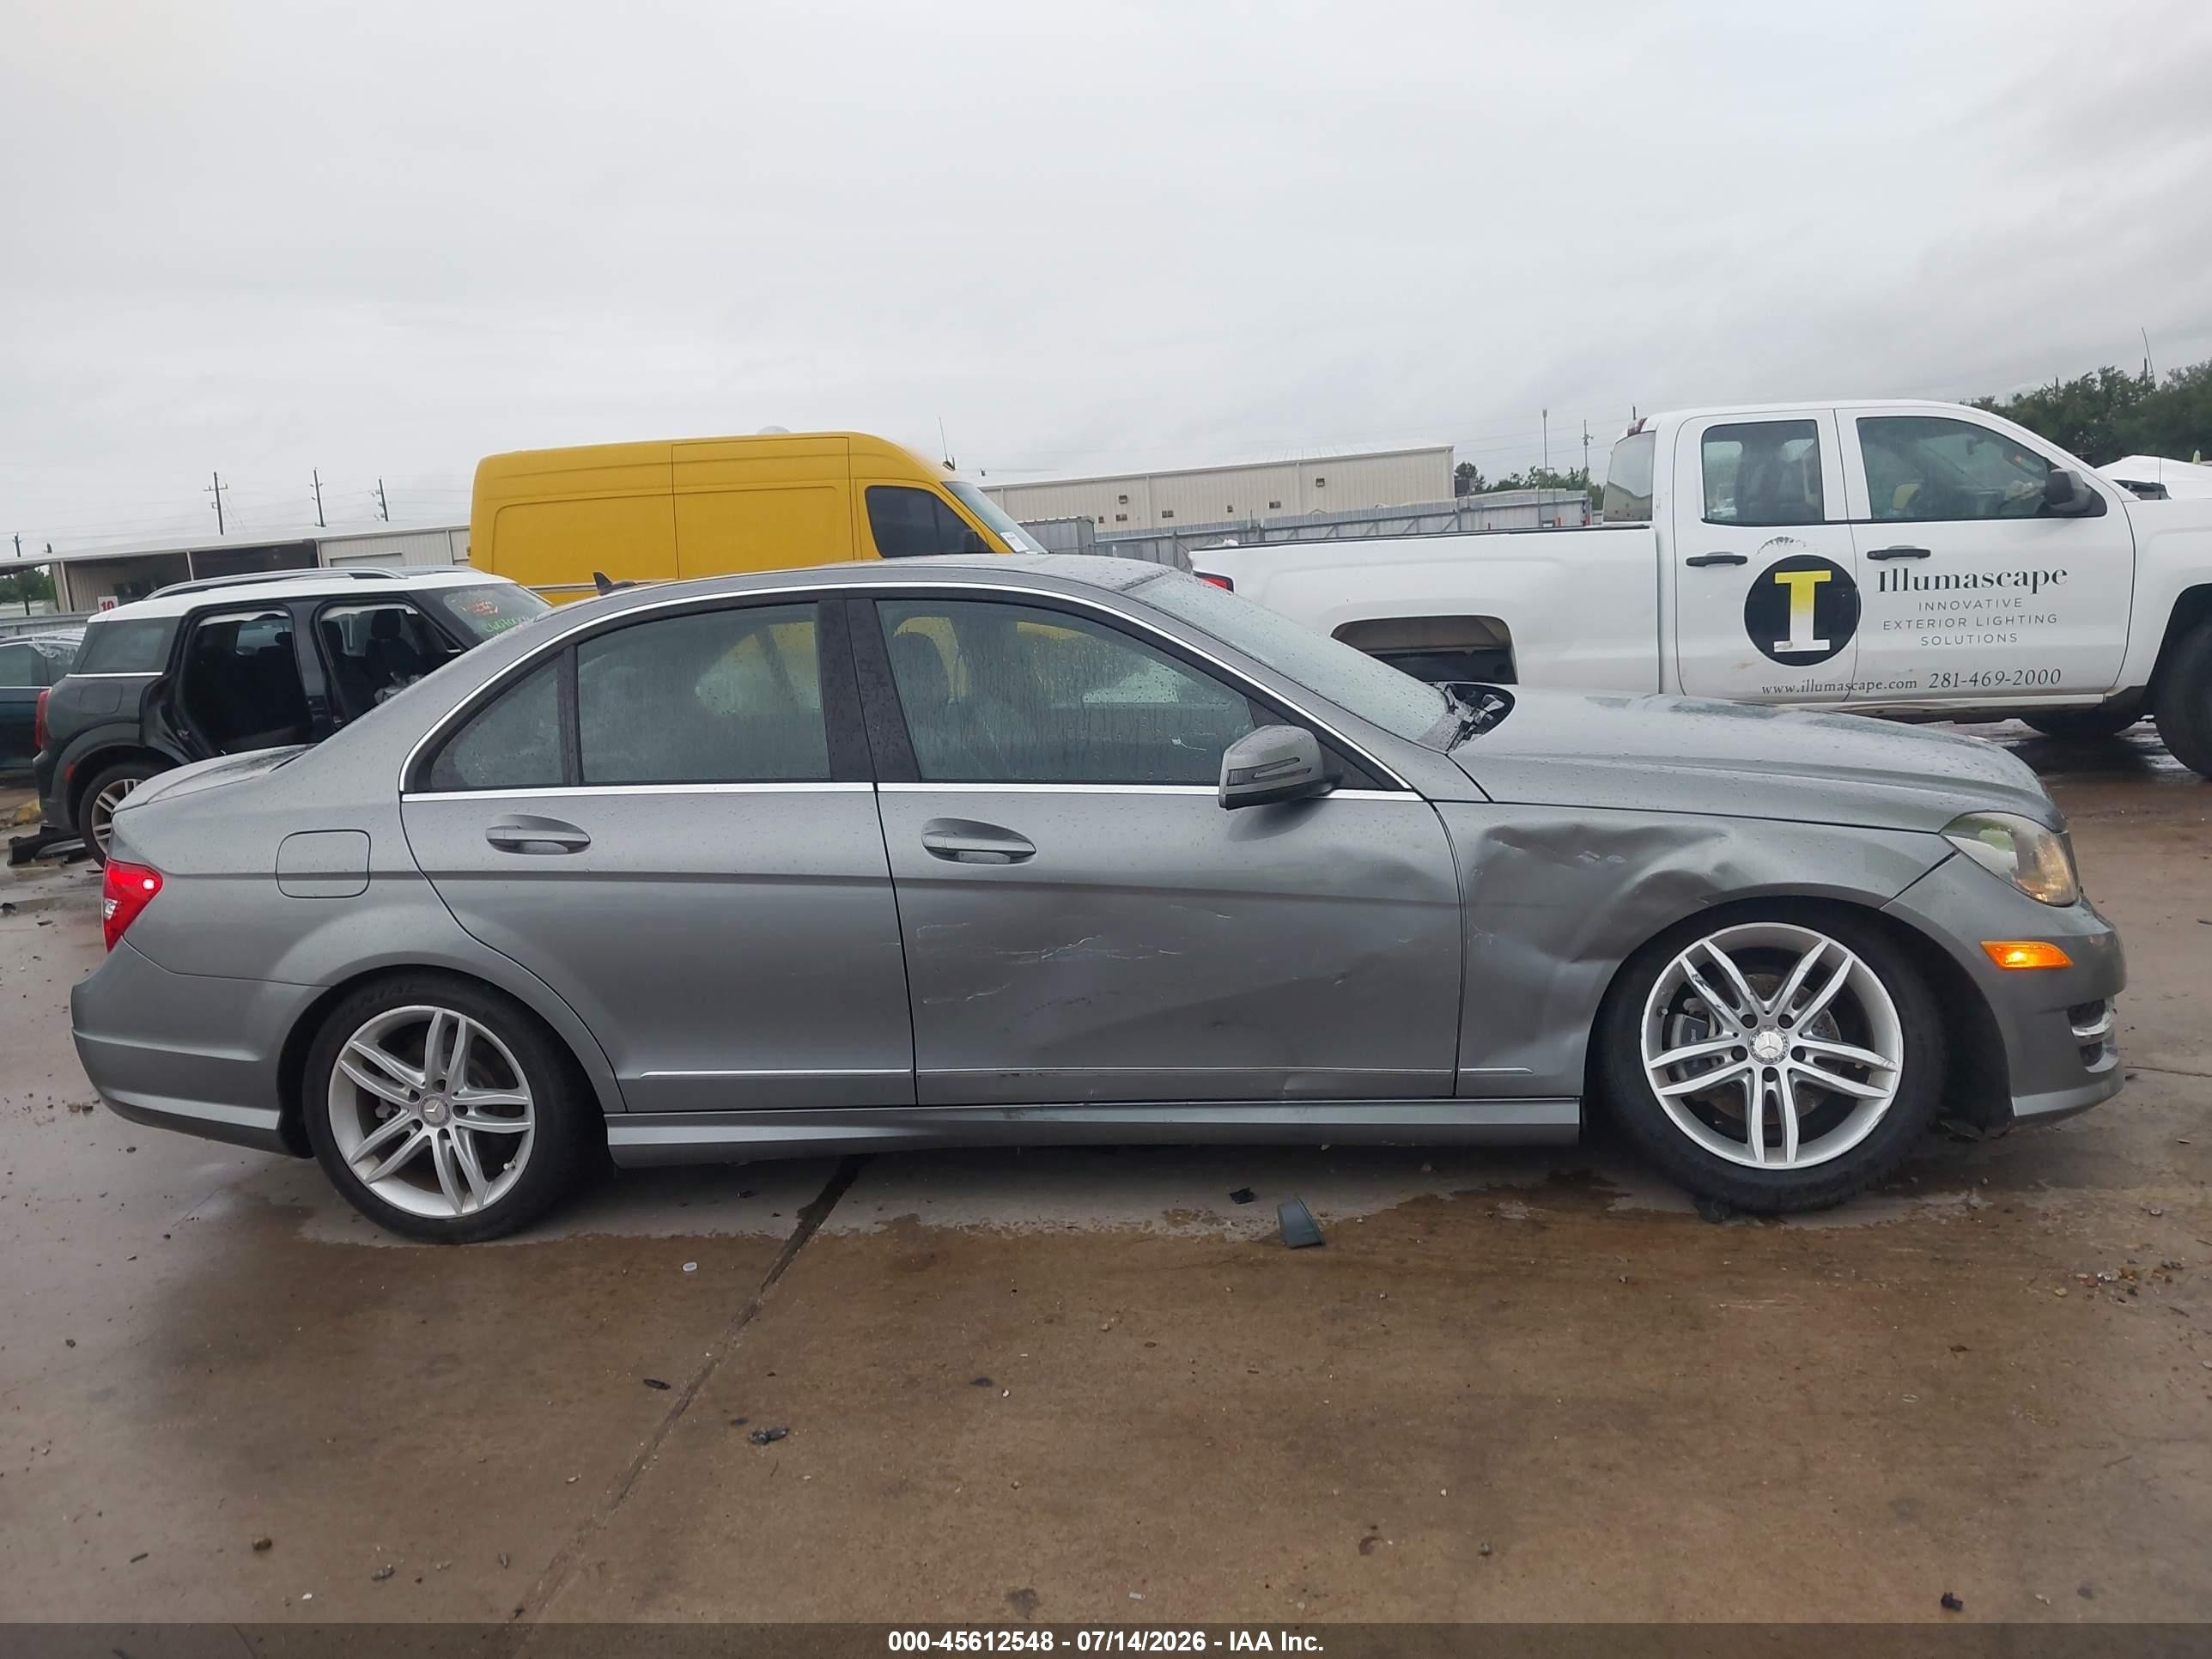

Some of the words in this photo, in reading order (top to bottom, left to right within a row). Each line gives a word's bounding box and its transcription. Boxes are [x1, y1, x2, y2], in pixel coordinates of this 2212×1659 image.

[1877, 568, 2068, 594] Illumascape
[1774, 570, 1831, 653] I
[1918, 598, 2022, 611] INNOVATIVE
[1883, 617, 1966, 630] EXTERIOR
[1976, 614, 2057, 627] LIGHTING
[1921, 633, 2018, 646] SOLUTIONS
[1761, 678, 1917, 694] www.illumascape.com
[1929, 668, 2062, 688] 281-469-2000
